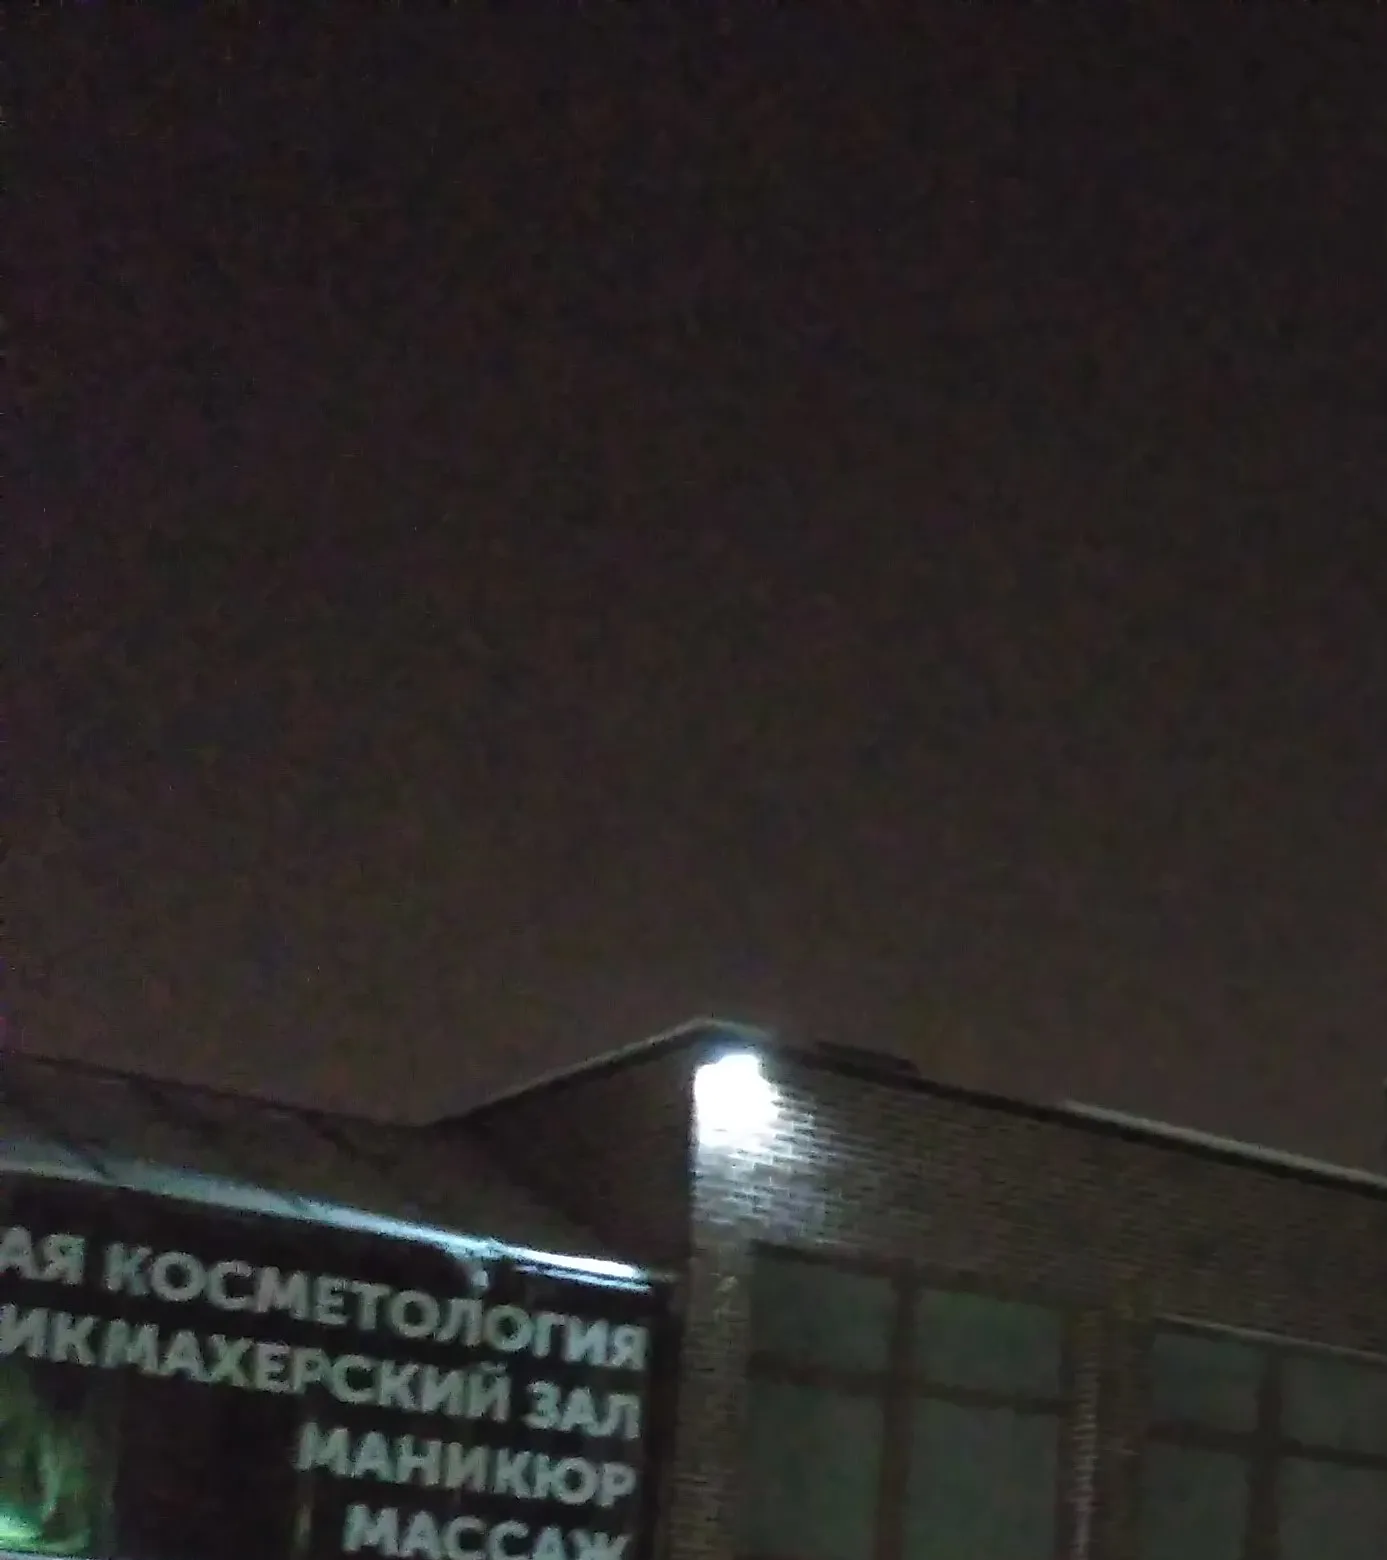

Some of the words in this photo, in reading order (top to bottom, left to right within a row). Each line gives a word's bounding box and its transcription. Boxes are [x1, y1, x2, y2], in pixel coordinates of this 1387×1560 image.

[0, 1302, 512, 1422] ИКМАХЕРСКИЙ
[524, 1380, 641, 1440] ЗАЛ
[103, 1242, 651, 1372] КОСМЕТОЛОГИЯ
[298, 1423, 637, 1507] МАНИКЮР
